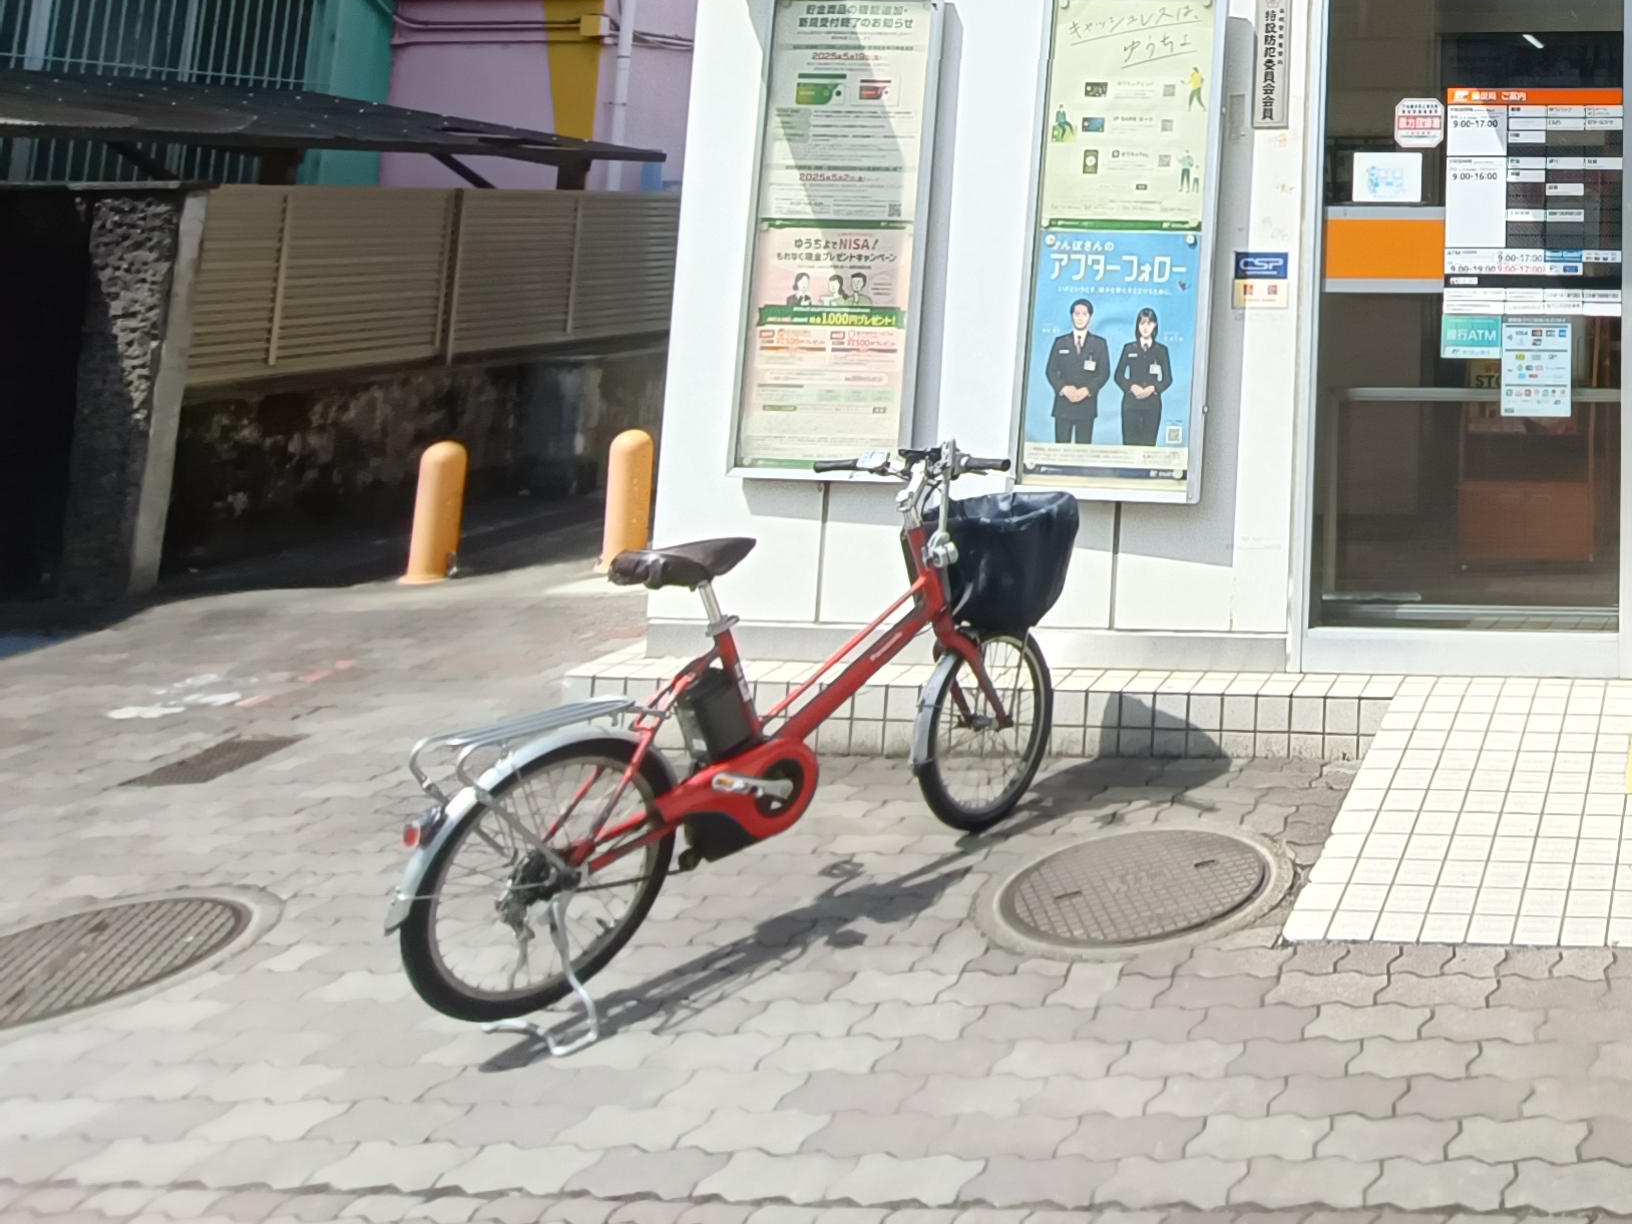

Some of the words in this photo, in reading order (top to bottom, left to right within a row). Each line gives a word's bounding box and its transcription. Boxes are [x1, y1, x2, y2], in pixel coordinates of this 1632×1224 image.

[1262, 10, 1277, 120] 特設防犯委員会会員
[1501, 91, 1527, 101] ご案内
[1050, 253, 1187, 283] アフターフォロー
[1239, 257, 1284, 270] CSP
